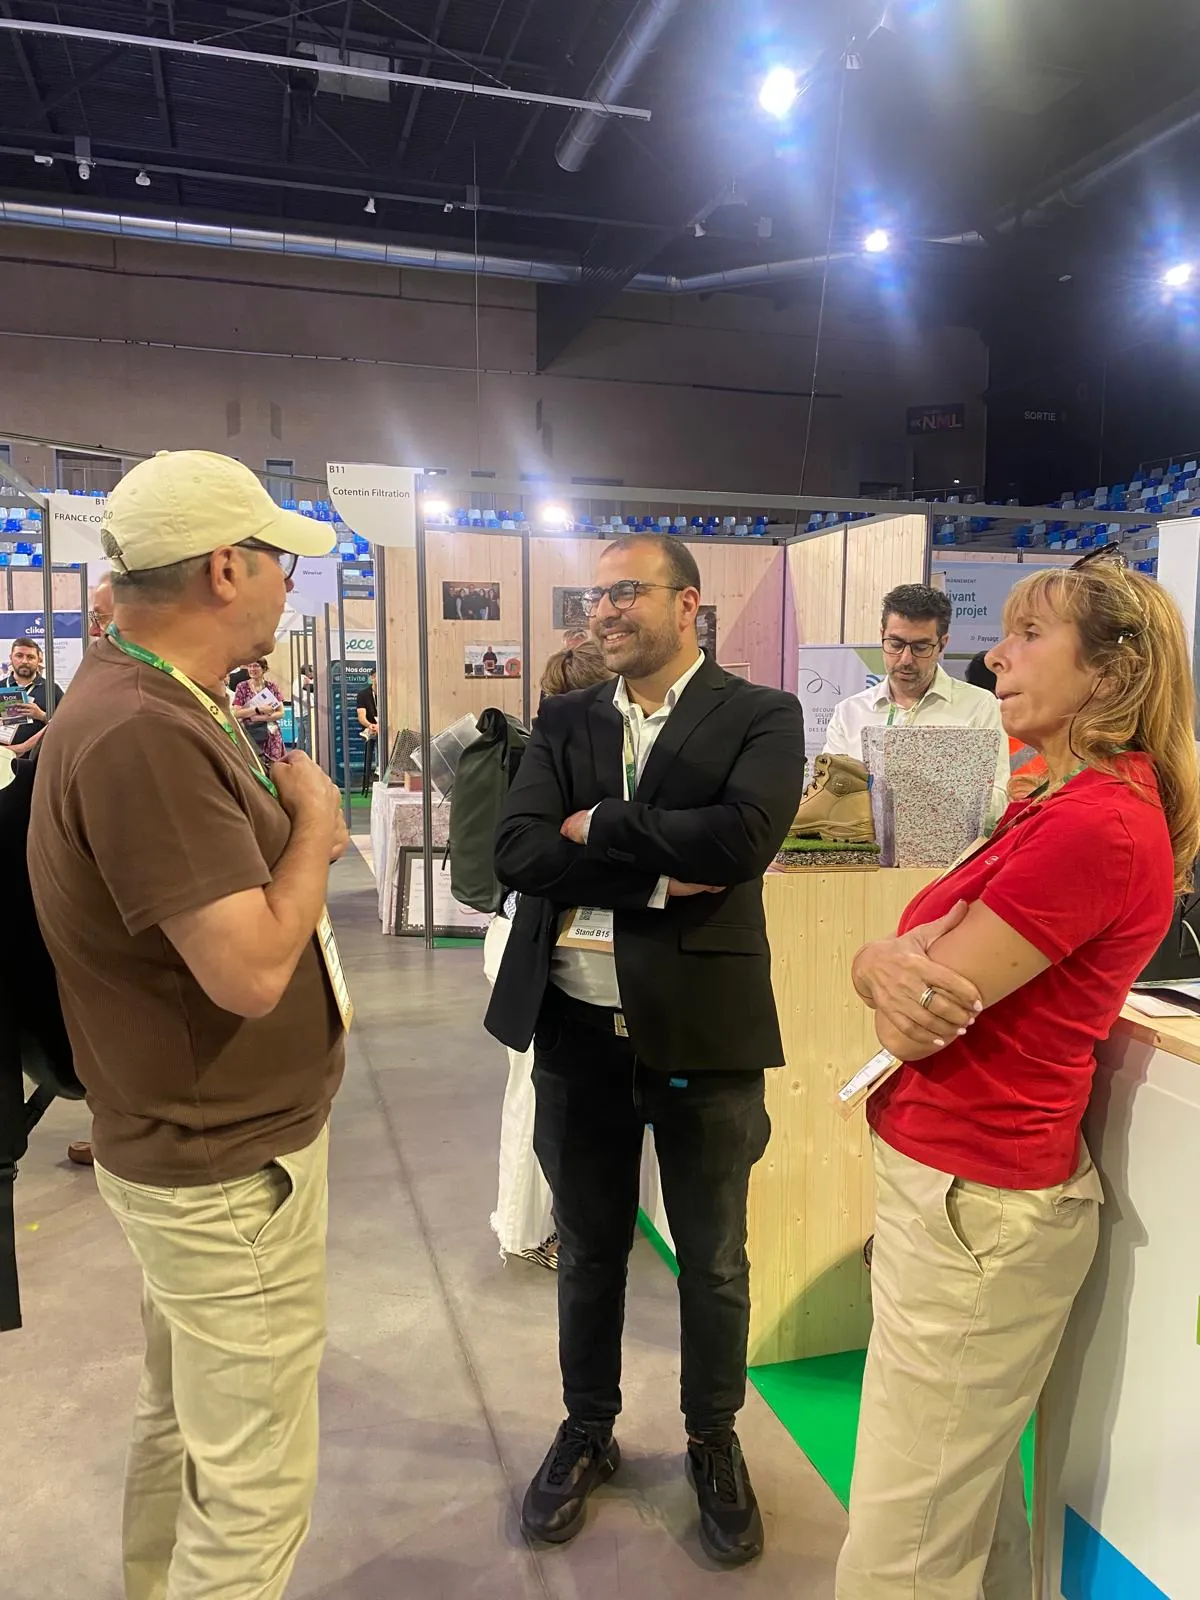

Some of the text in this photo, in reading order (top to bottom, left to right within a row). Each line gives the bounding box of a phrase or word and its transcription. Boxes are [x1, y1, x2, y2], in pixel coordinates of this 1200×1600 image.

[1024, 410, 1057, 421] SORTIE
[329, 465, 345, 474] B11
[332, 487, 410, 498] Cotentin Filtration
[54, 513, 103, 523] FRANCE CO
[955, 604, 988, 619] projet
[977, 635, 1000, 643] Paysage
[575, 928, 610, 938] Stand B15
